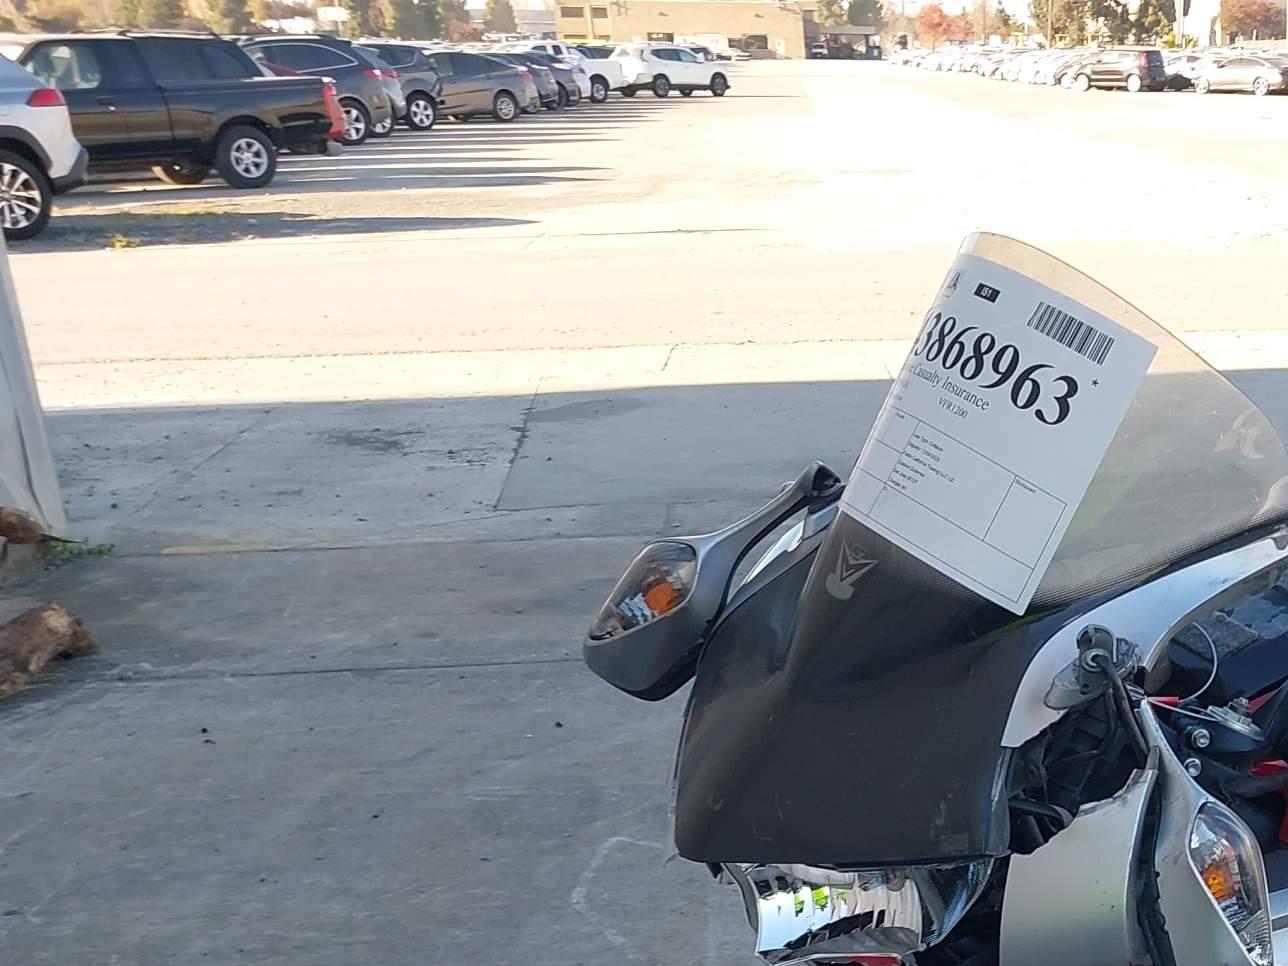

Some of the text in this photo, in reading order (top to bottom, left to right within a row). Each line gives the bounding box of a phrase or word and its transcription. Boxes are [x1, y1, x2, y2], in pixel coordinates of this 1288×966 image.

[912, 362, 990, 411] Casualty Insurance
[938, 396, 969, 419] VFR1200
